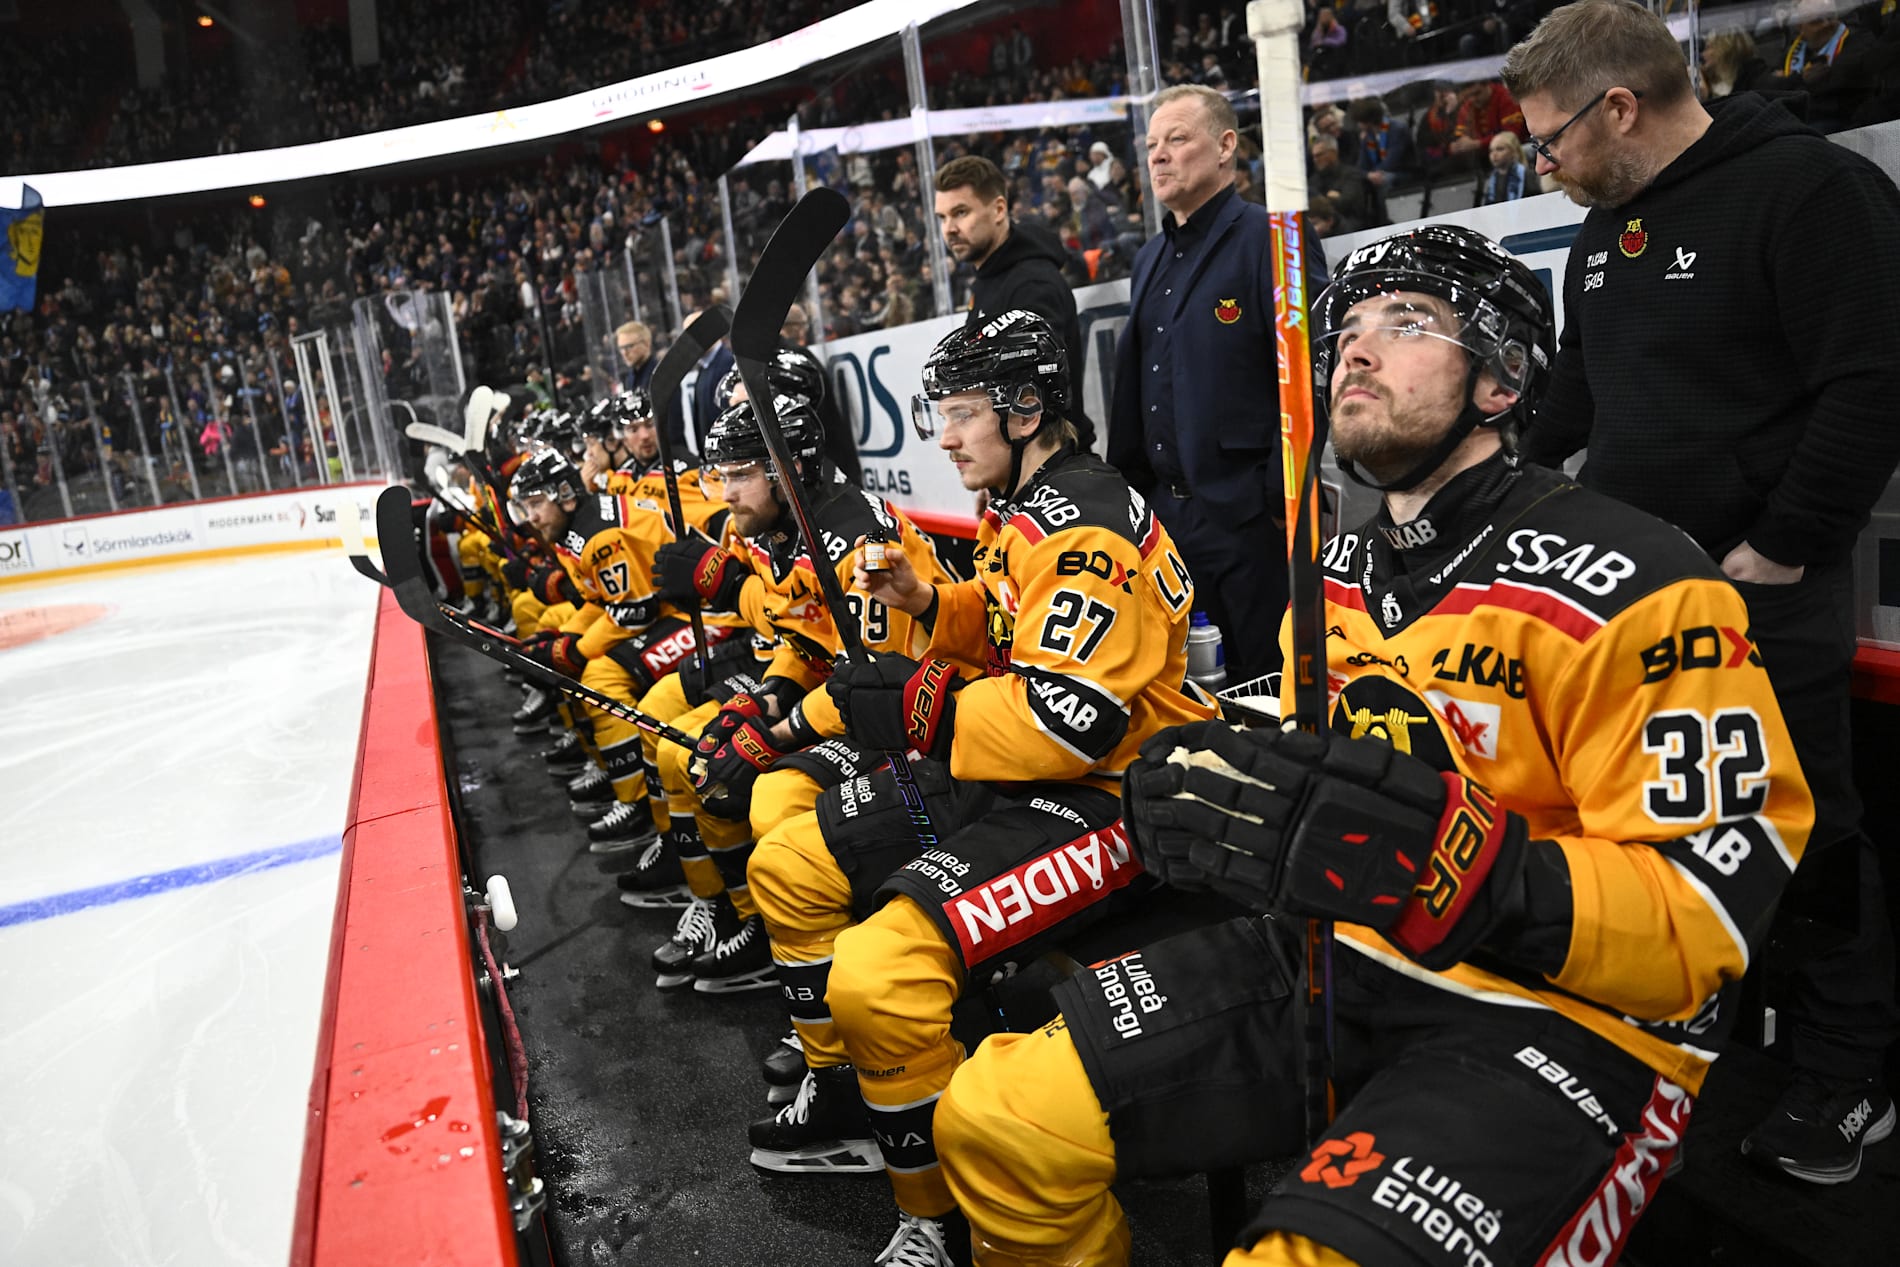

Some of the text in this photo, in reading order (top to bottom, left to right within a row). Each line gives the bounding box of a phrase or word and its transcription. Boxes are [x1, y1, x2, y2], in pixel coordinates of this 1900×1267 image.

[1344, 241, 1394, 271] kry
[1664, 272, 1695, 280] BAUER
[1023, 484, 1081, 527] SSAB
[598, 560, 631, 597] 67
[1496, 528, 1637, 597] SSAB
[1038, 587, 1118, 666] 27
[1641, 705, 1771, 824] 32
[1029, 797, 1090, 830] BAUER
[1095, 963, 1143, 1040] Energi
[1120, 953, 1168, 1014] Luleå
[1513, 1045, 1619, 1136] BAUER
[1837, 1098, 1873, 1144] HOKA
[1391, 1156, 1503, 1246] Luleå
